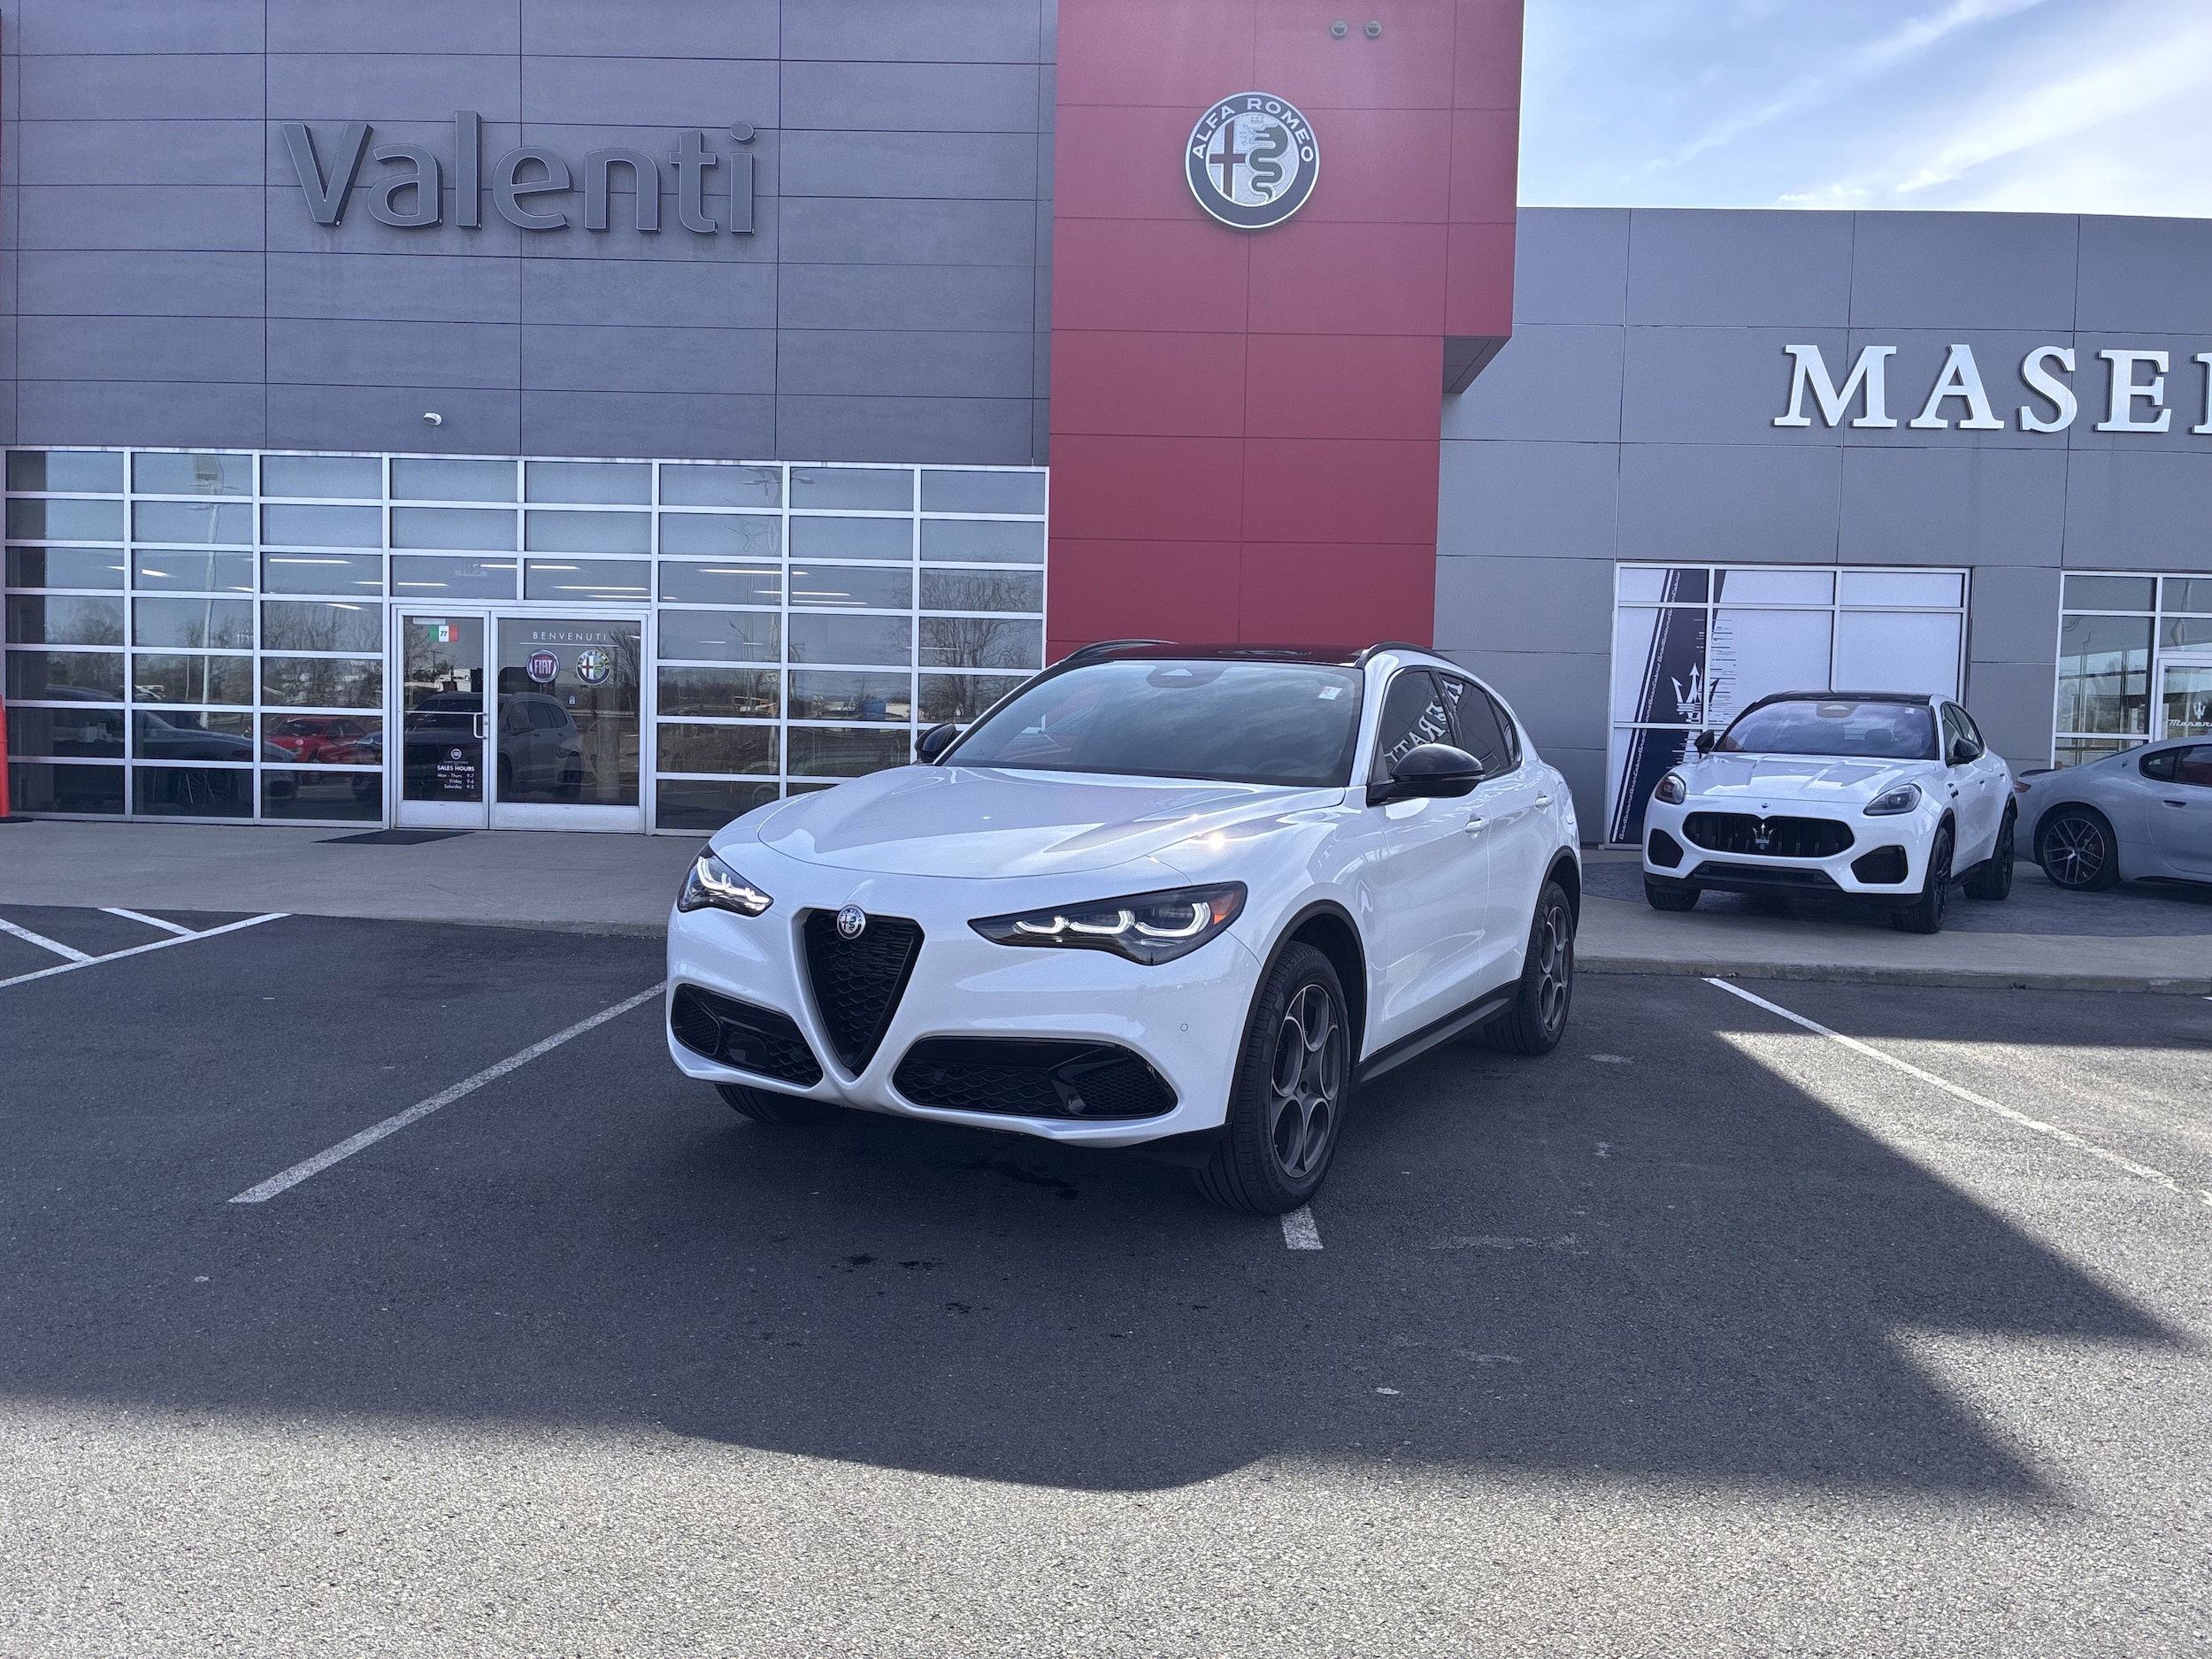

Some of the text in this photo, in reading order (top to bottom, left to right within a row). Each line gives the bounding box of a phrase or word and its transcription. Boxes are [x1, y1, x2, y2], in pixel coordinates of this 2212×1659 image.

[1193, 97, 1315, 163] ALFA ROMEO
[280, 111, 757, 234] Valenti
[533, 631, 607, 641] BENVENUTI
[534, 659, 553, 674] FIAT
